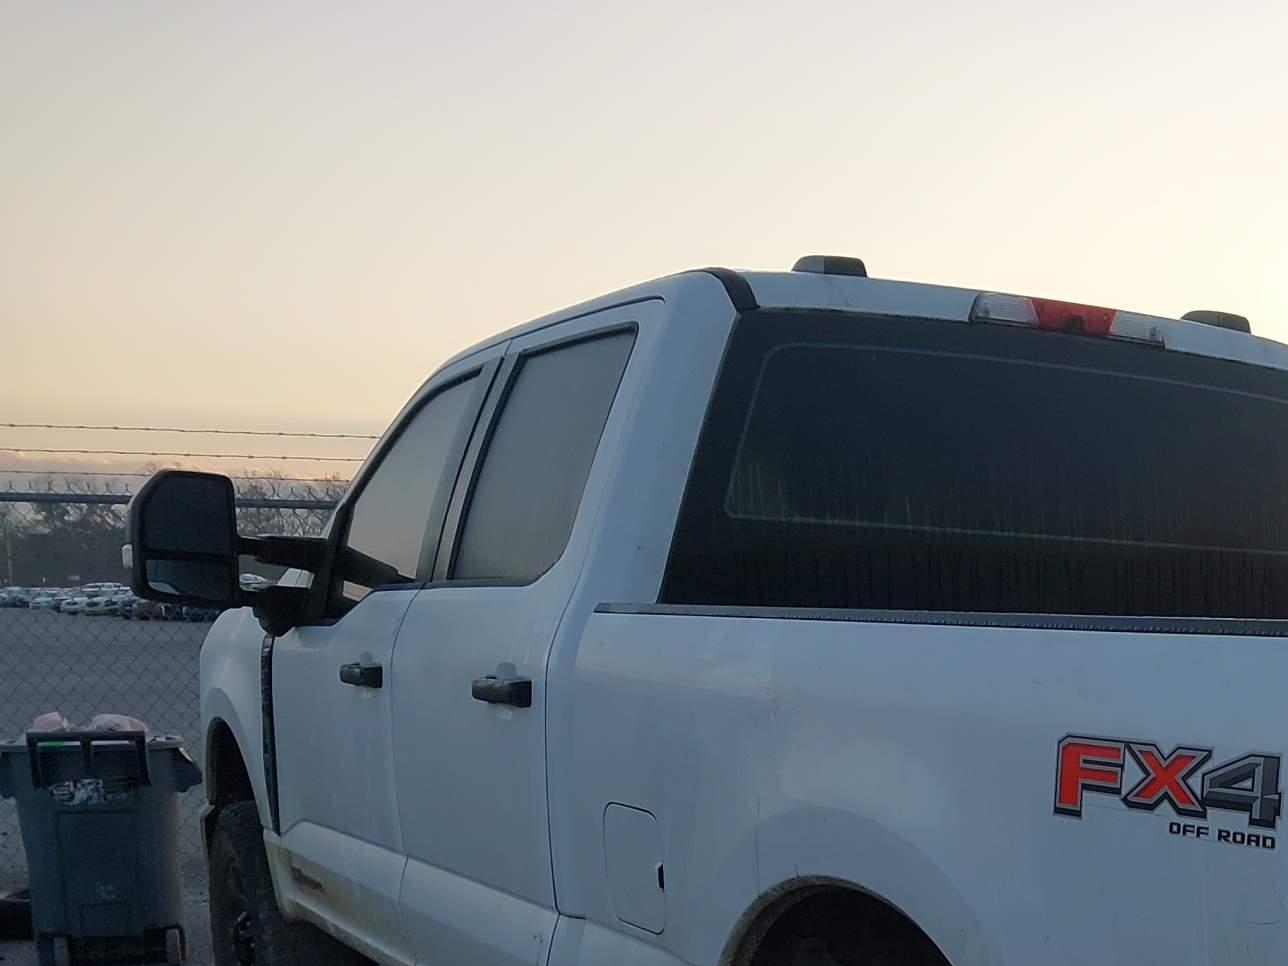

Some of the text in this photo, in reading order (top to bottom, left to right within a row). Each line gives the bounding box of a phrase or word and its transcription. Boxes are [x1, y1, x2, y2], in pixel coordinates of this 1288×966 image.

[1054, 734, 1283, 829] FX4
[1168, 821, 1276, 849] OFF ROAD
